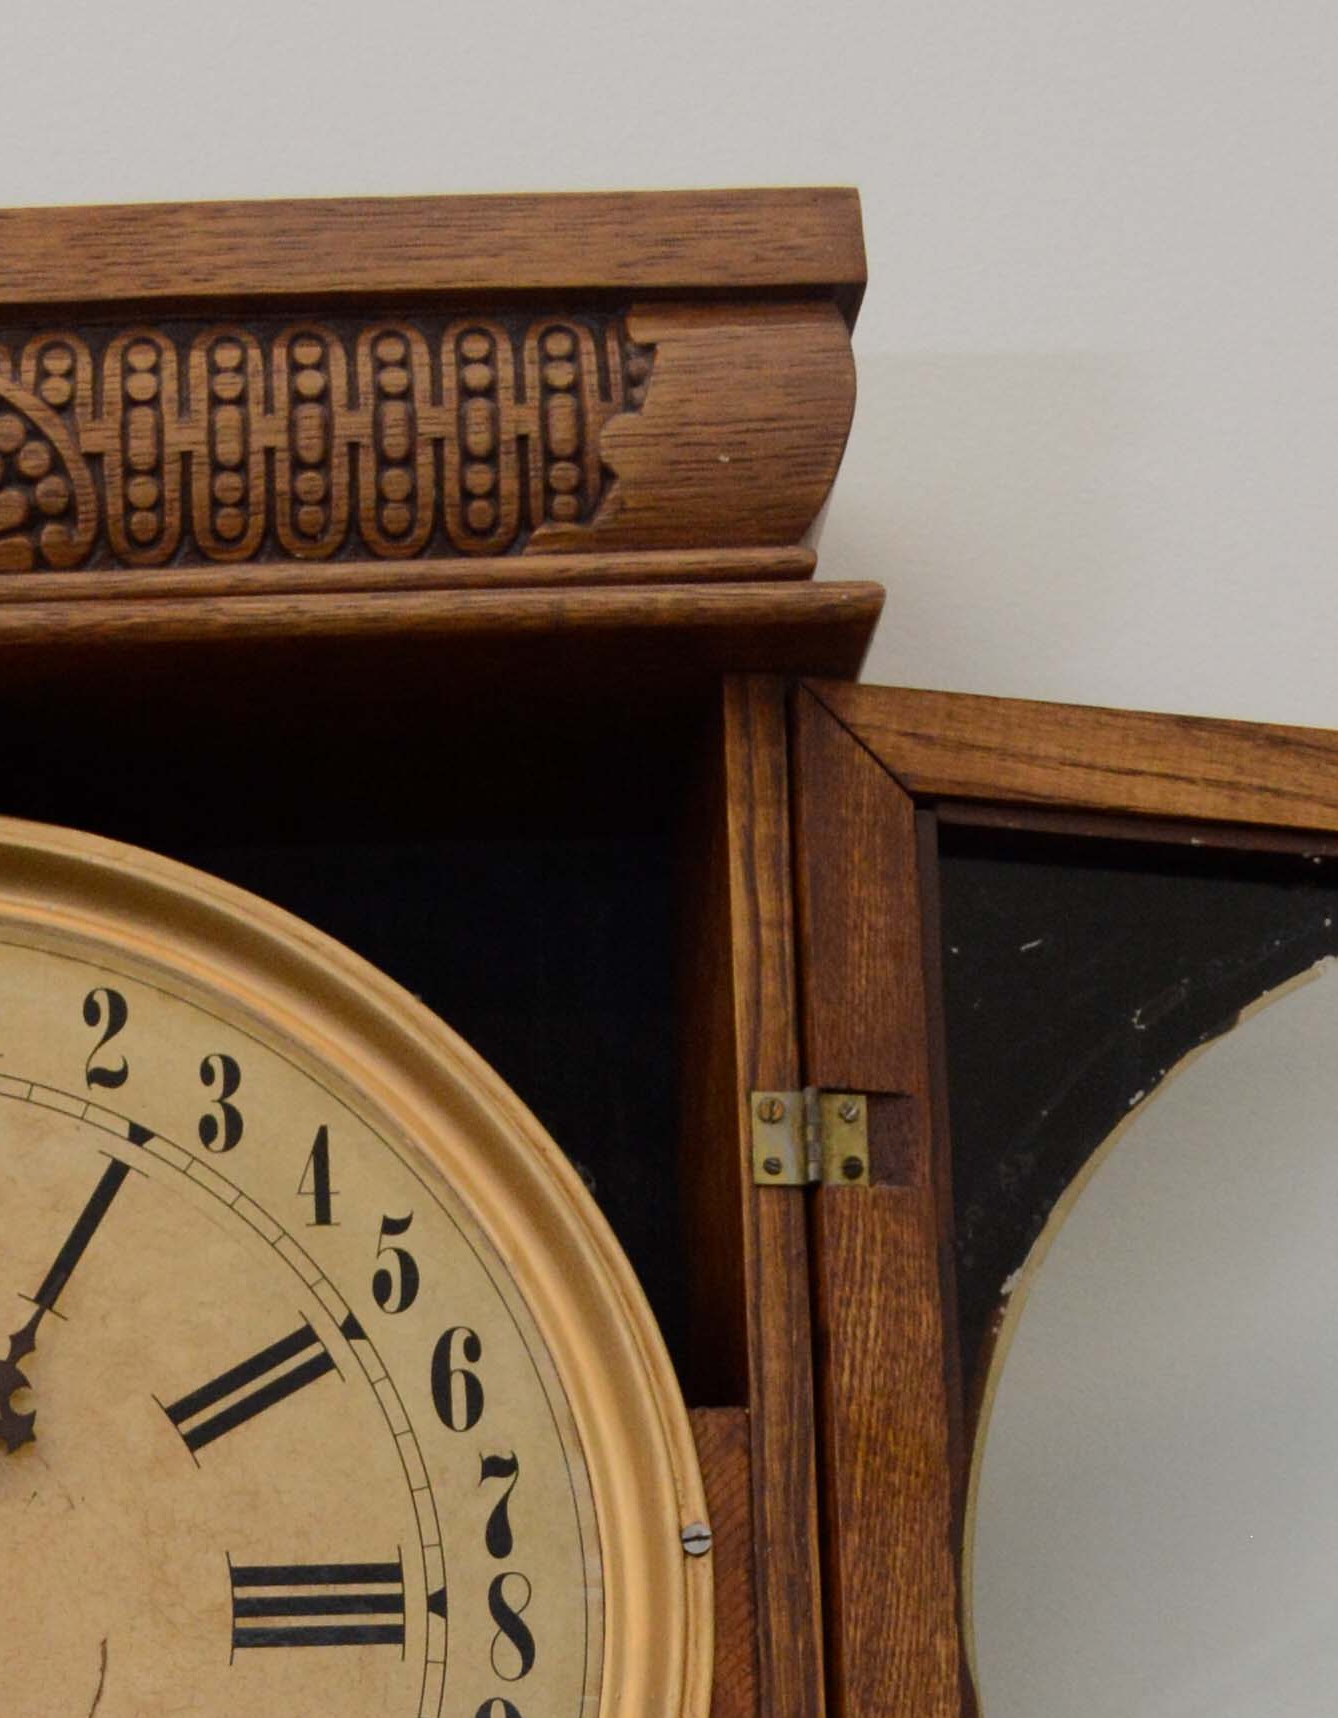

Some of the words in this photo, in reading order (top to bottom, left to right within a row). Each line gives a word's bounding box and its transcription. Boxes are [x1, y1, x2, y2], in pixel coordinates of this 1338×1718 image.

[81, 987, 130, 1090] 2
[198, 1053, 244, 1154] 3
[296, 1124, 341, 1227] 4
[371, 1209, 420, 1314] 5
[431, 1326, 485, 1433] 6
[478, 1450, 520, 1559] 7
[487, 1571, 536, 1681] 8
